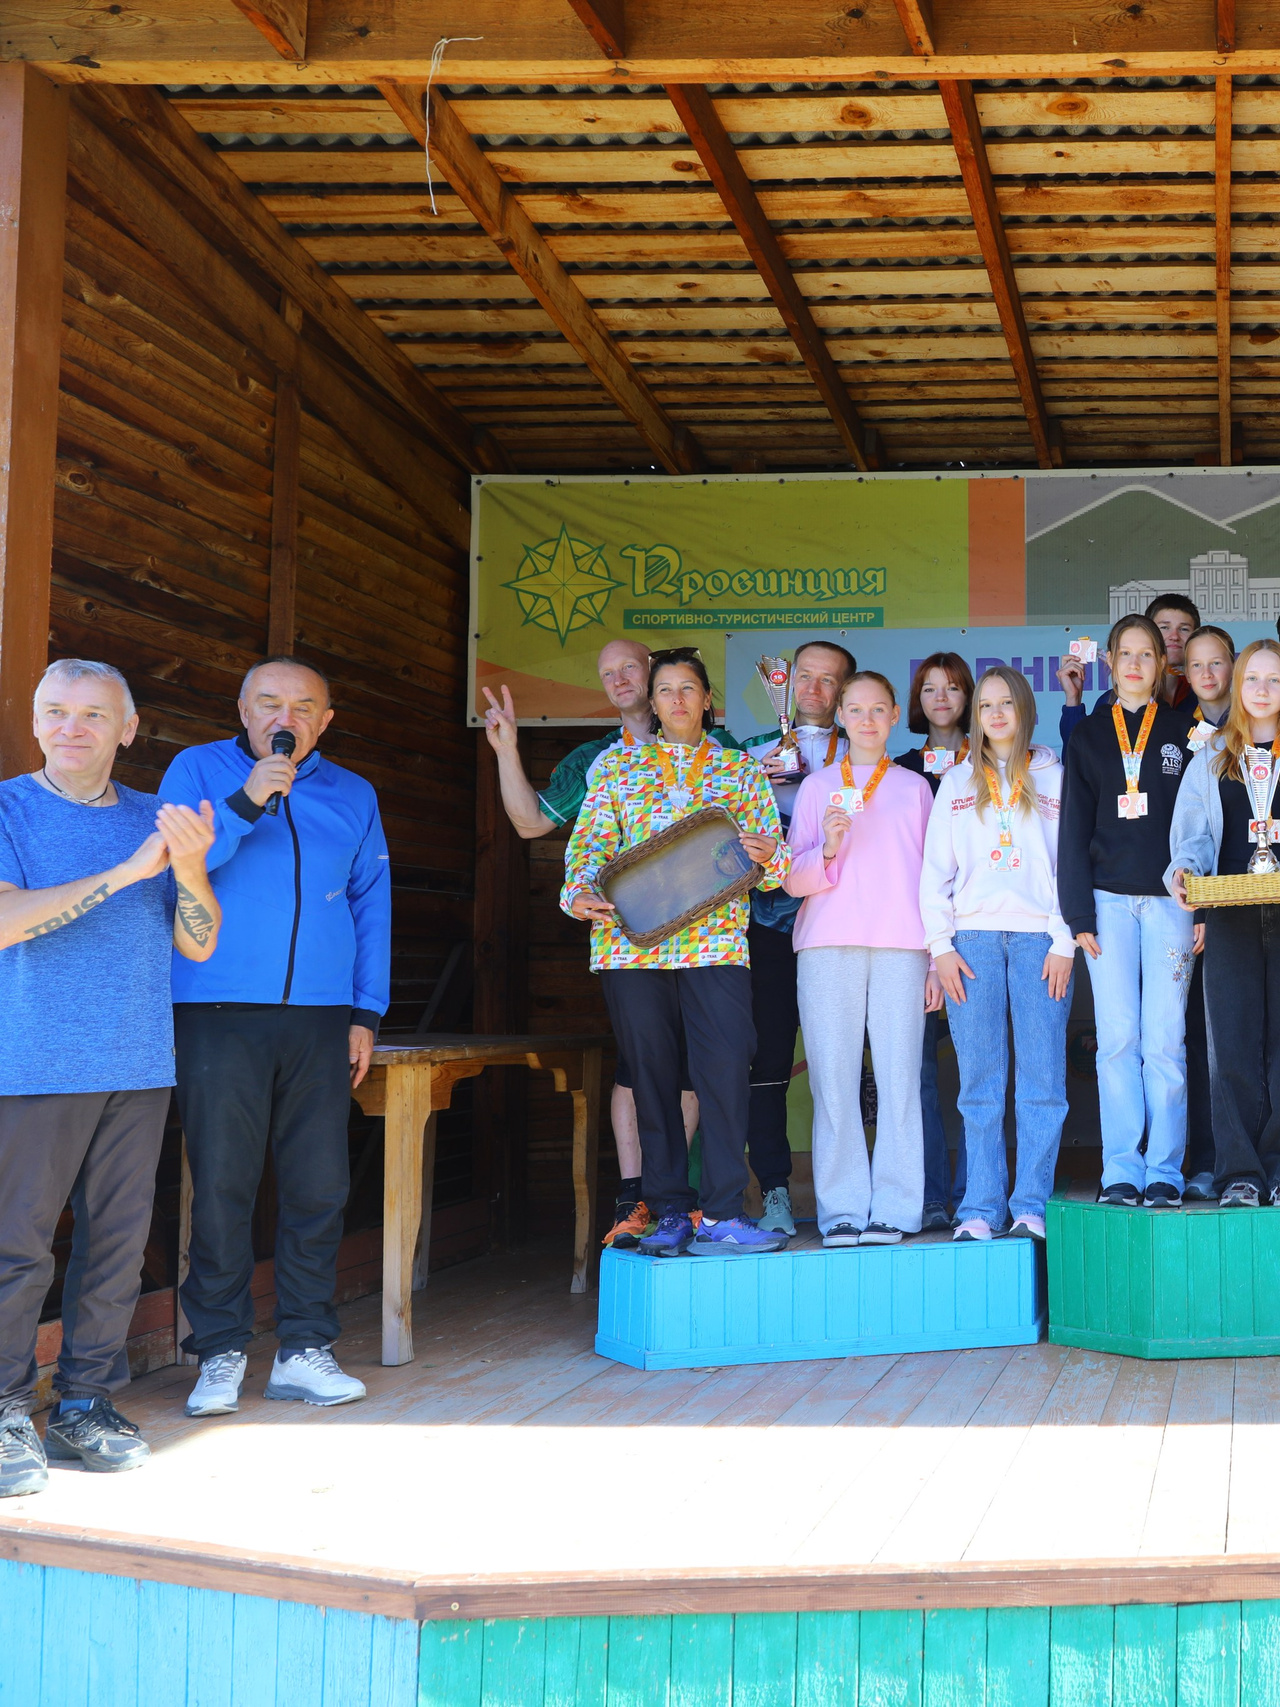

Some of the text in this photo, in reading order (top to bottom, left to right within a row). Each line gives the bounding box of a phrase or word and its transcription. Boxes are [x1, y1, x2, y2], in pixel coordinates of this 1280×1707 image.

[620, 543, 887, 607] Провинция
[632, 611, 875, 625] СПОРТИВНО-ТУРИСТИЧЕСКИЙ ЦЕНТР
[855, 801, 863, 810] 2
[1012, 858, 1020, 868] 2
